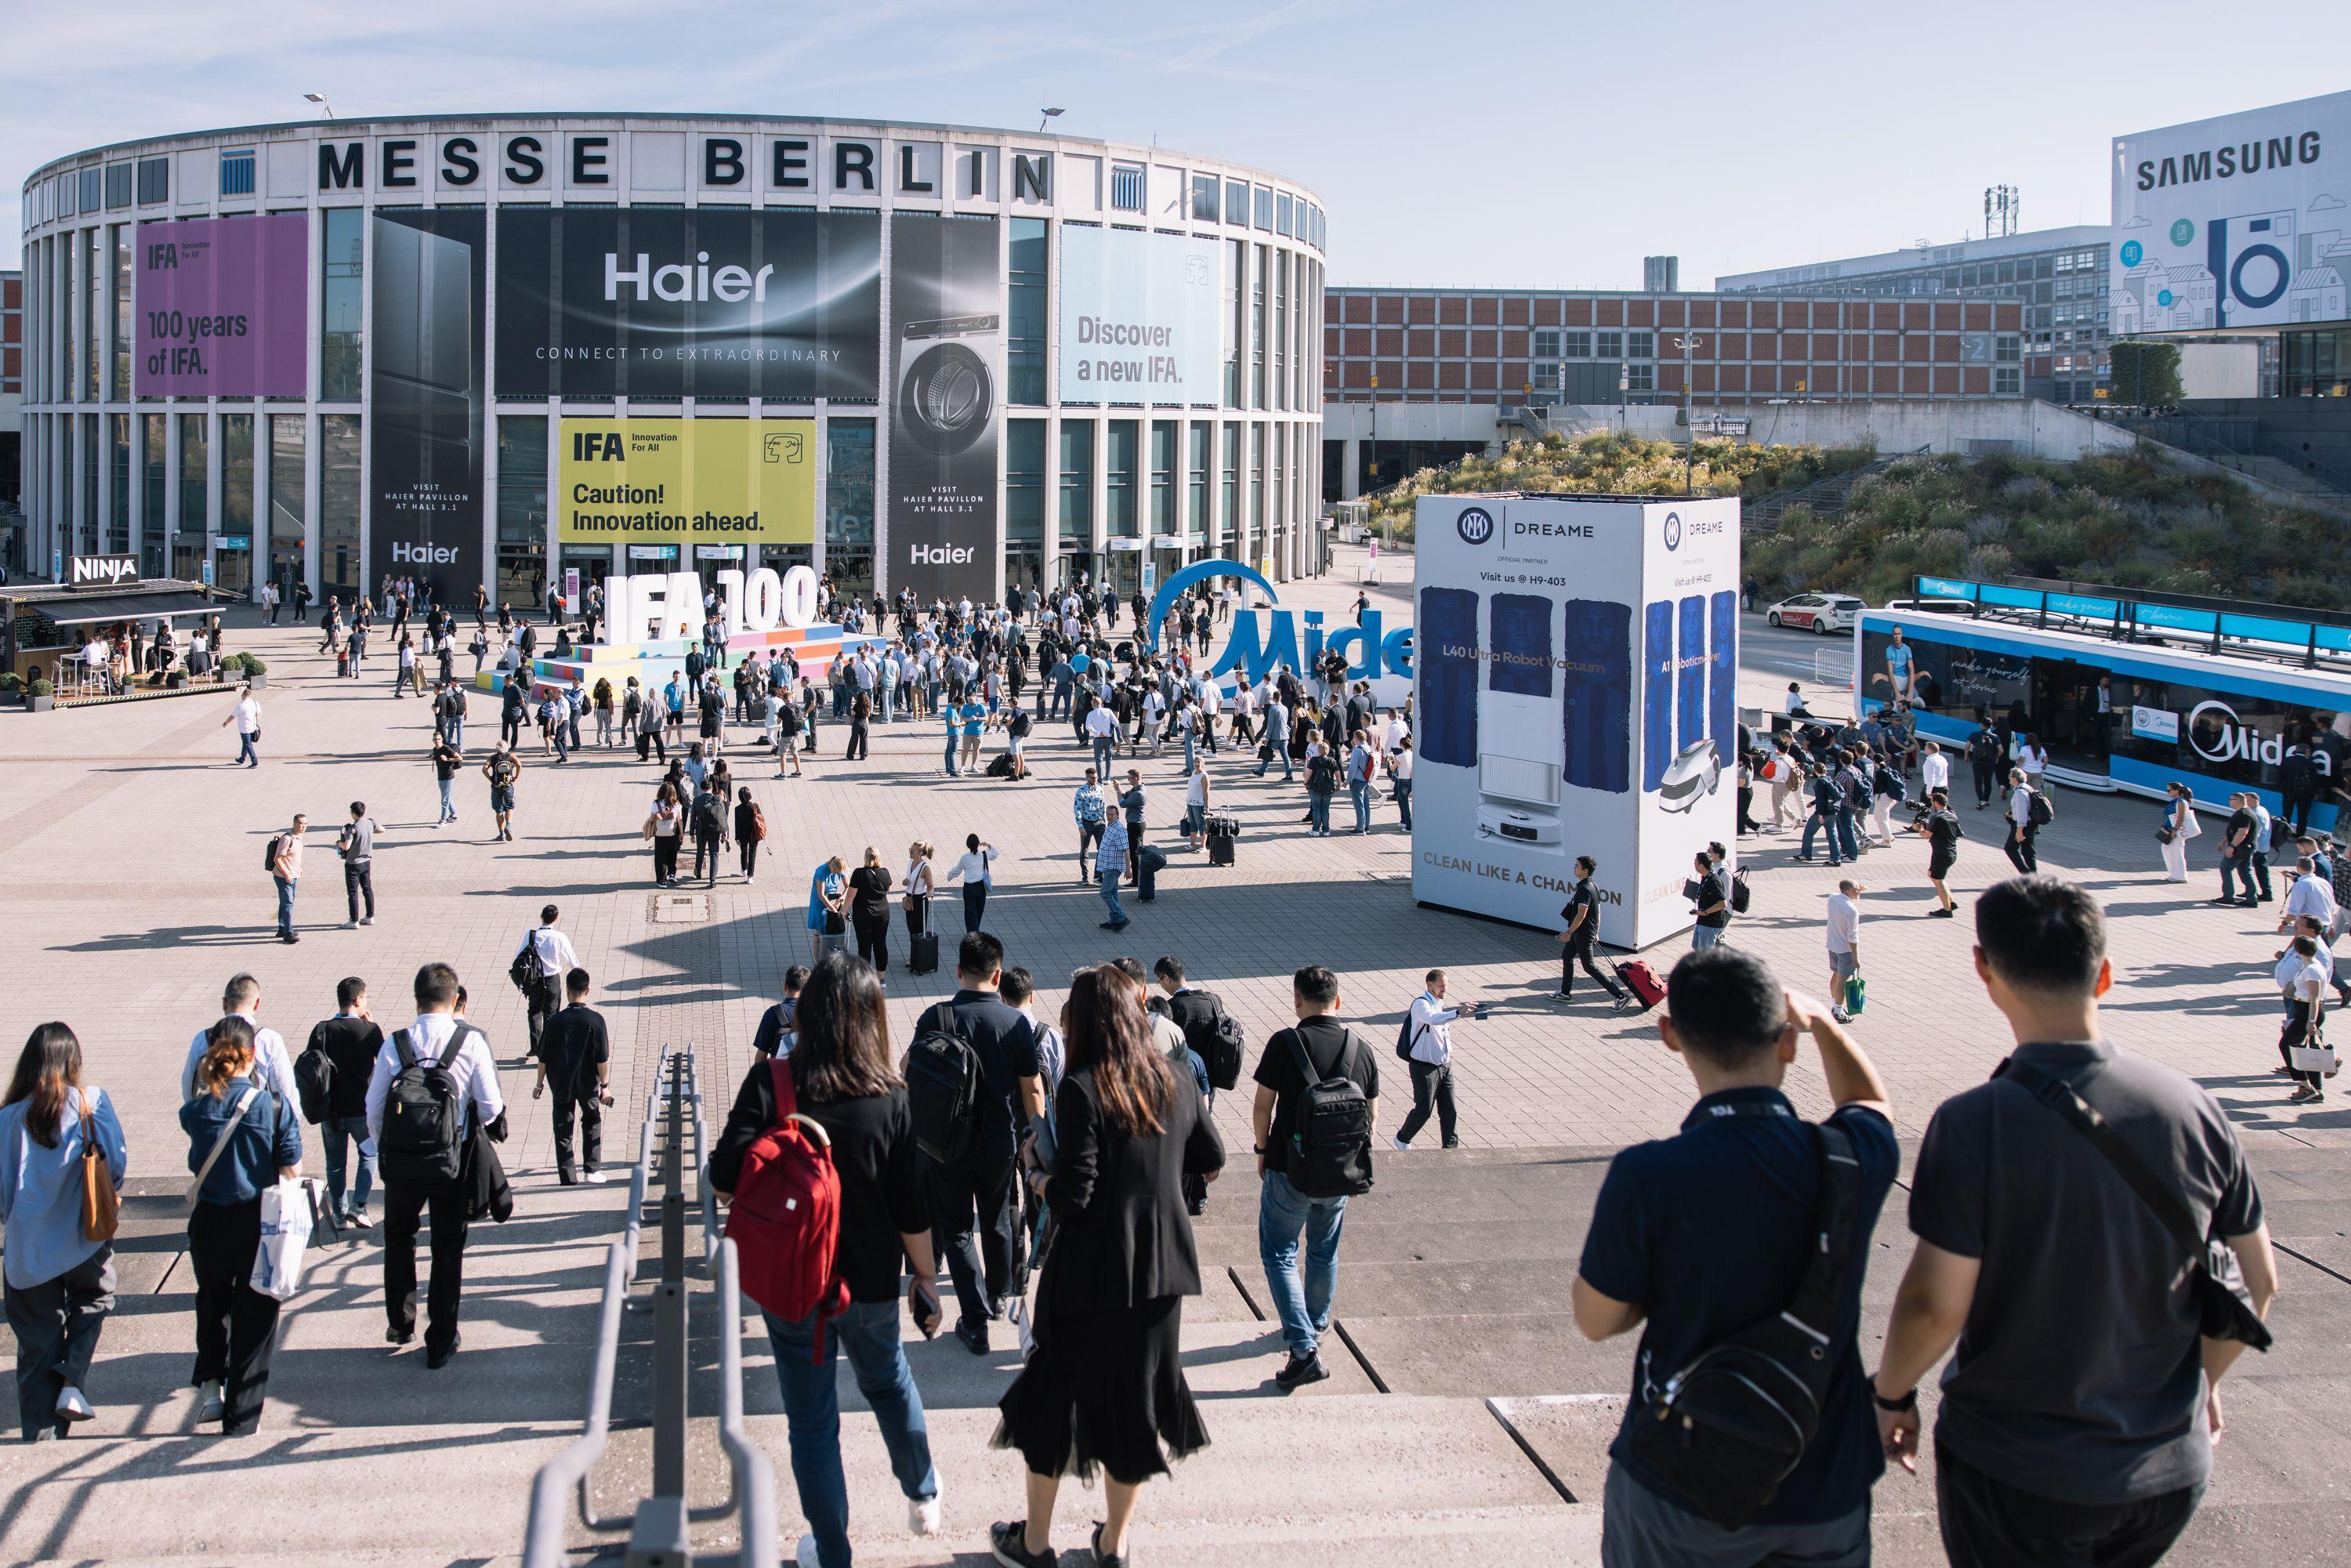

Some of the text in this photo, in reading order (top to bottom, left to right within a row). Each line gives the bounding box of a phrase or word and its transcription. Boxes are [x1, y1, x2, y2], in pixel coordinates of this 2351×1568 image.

[319, 136, 1049, 200] MESSE BERLIN
[2137, 131, 2320, 191] SAMSUNG
[148, 243, 178, 270] IFA
[605, 251, 773, 302] Haier
[148, 311, 248, 344] 100 years
[1078, 316, 1172, 346] Discover
[148, 346, 208, 376] of IFA.
[536, 346, 841, 363] CONNECT TO EXTRAORDINARY
[1077, 357, 1183, 383] a new IFA.
[573, 433, 625, 462] IFA
[573, 483, 664, 505] Caution!
[573, 509, 764, 531] Innovation ahead.
[1514, 523, 1594, 538] DREAME
[1690, 522, 1722, 535] DREAME
[393, 541, 458, 563] Haier
[911, 542, 974, 564] Haier
[74, 557, 136, 585] NINJA
[1480, 572, 1501, 581] Visit
[1518, 574, 1527, 583] @
[1530, 576, 1566, 586] H9-403
[1674, 578, 1684, 587] Visit
[604, 566, 817, 646] IFA 100
[1443, 644, 1605, 674] L40 Ultra Robot Vacuum
[1661, 652, 1721, 673] A1 oboticmower
[1951, 658, 2031, 686] make yourself
[1953, 677, 1998, 693] at home
[2155, 717, 2175, 729] Midea
[2188, 700, 2331, 777] Mida
[1423, 852, 1621, 906] CLEAN LIKE A CHAMON
[1644, 885, 1668, 905] CLEAN
